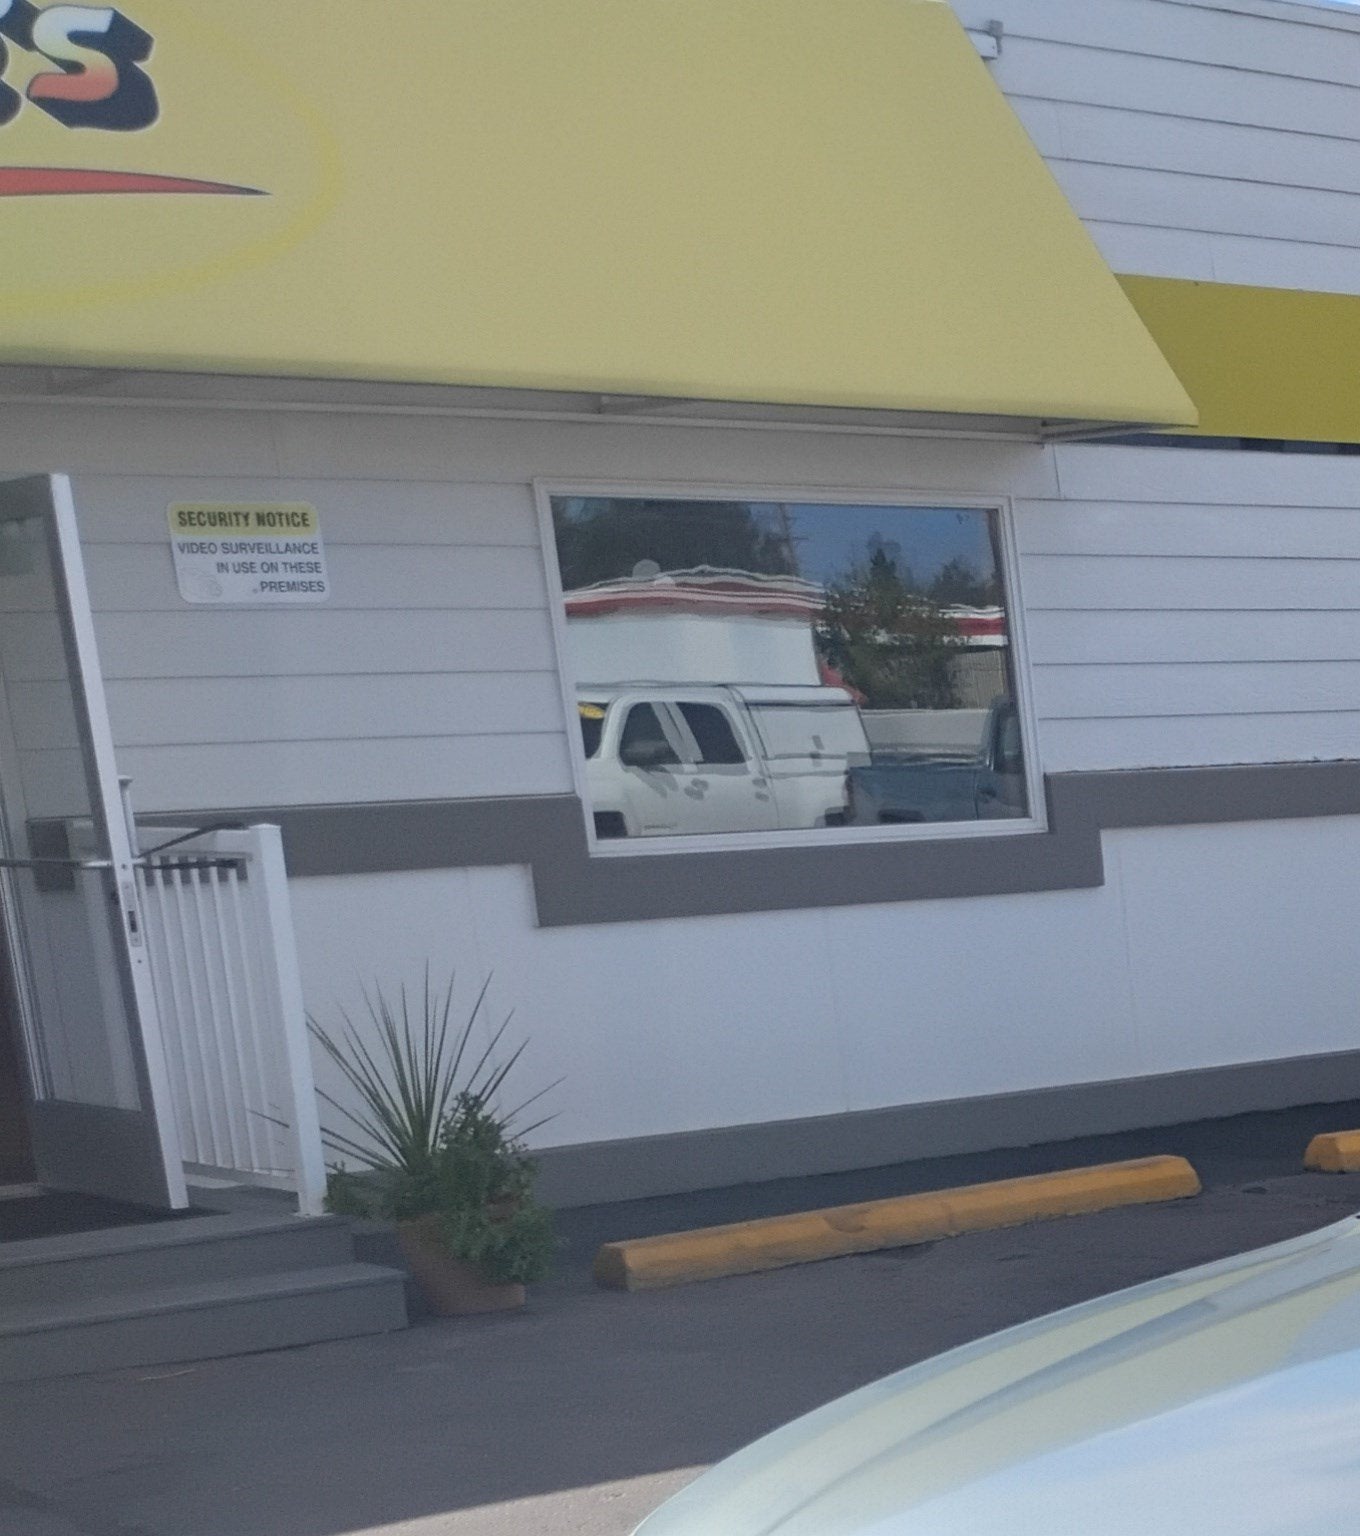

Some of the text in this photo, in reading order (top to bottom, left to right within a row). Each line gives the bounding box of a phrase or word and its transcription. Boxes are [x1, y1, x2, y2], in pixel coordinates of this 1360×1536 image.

[178, 511, 310, 527] SECURITY NOTICE
[178, 542, 320, 555] VIDEO SURVEILLANCE
[217, 562, 322, 573] IN USE ON THESE
[260, 581, 325, 592] PREMISES
